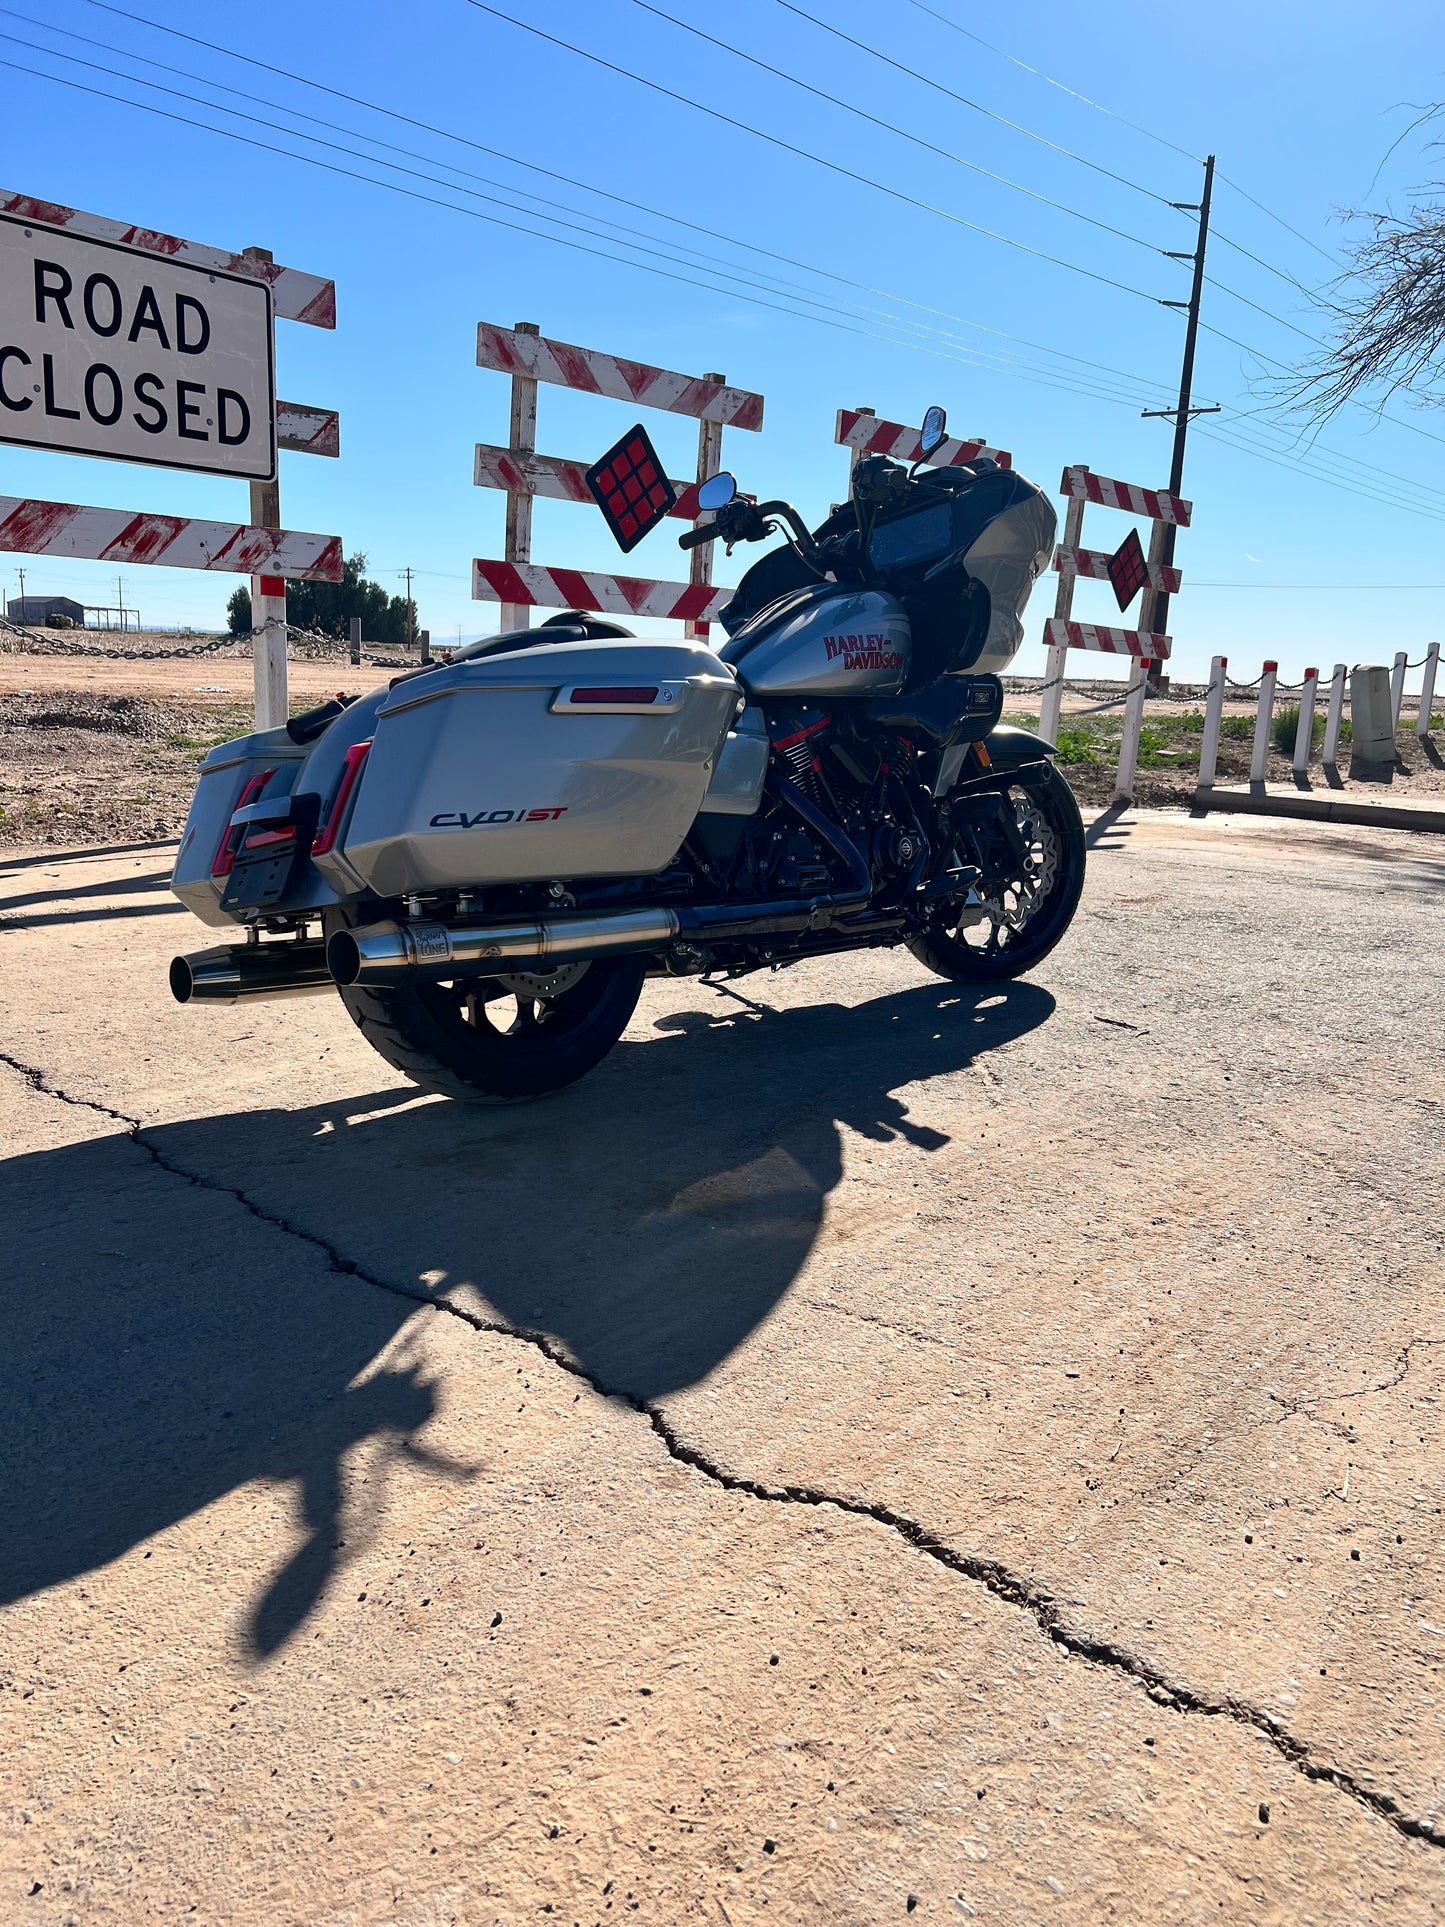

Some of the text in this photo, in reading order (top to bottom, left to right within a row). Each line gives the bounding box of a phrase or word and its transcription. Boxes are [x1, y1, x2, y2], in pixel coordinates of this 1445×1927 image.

[33, 258, 211, 355] ROAD
[0, 345, 251, 446] CLOSED
[823, 634, 892, 661] HARLEY-
[843, 651, 903, 671] DAVIDSON
